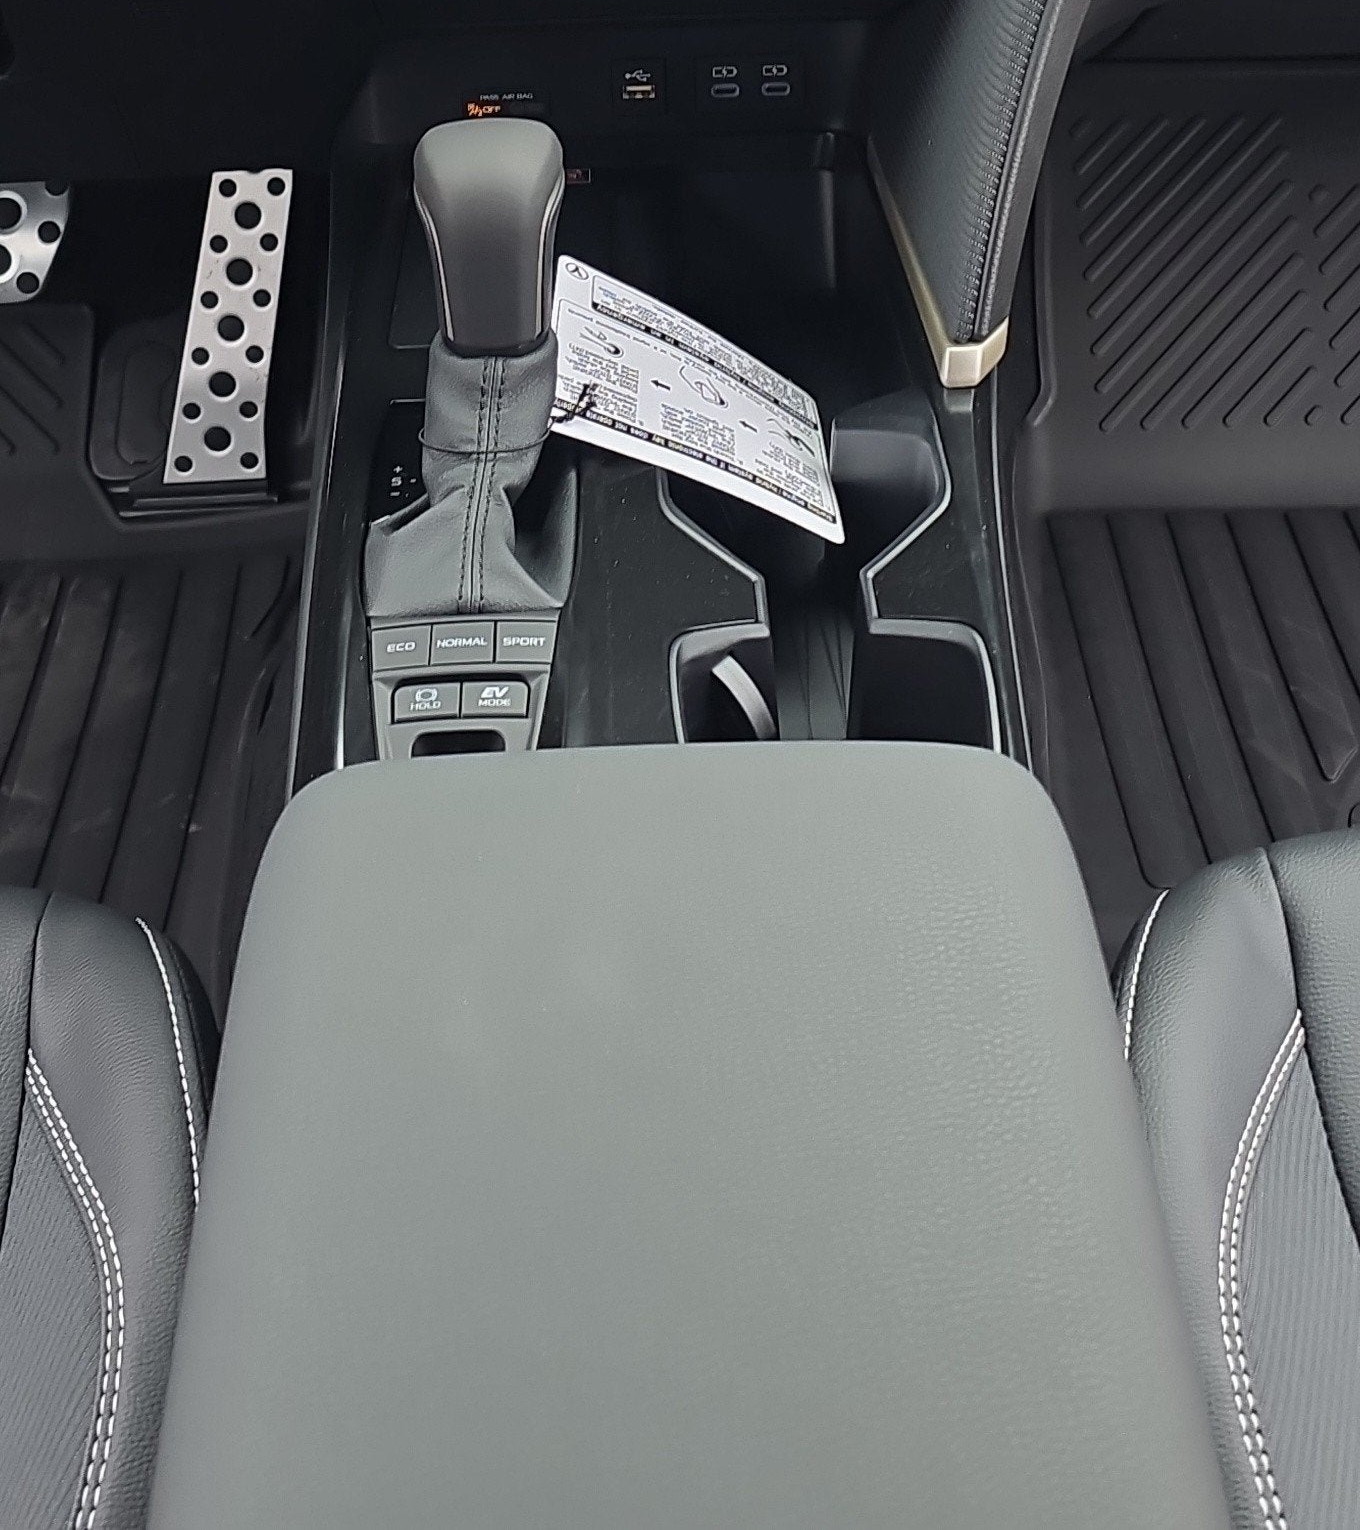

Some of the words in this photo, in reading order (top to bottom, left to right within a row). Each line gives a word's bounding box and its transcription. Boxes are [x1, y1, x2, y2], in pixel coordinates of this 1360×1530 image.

[727, 465, 754, 482] system
[386, 641, 416, 653] ECO
[436, 636, 488, 648] NORMAL
[503, 636, 546, 647] SPORT
[480, 686, 510, 699] EV
[409, 701, 441, 711] HOLD
[478, 698, 511, 707] MODE
